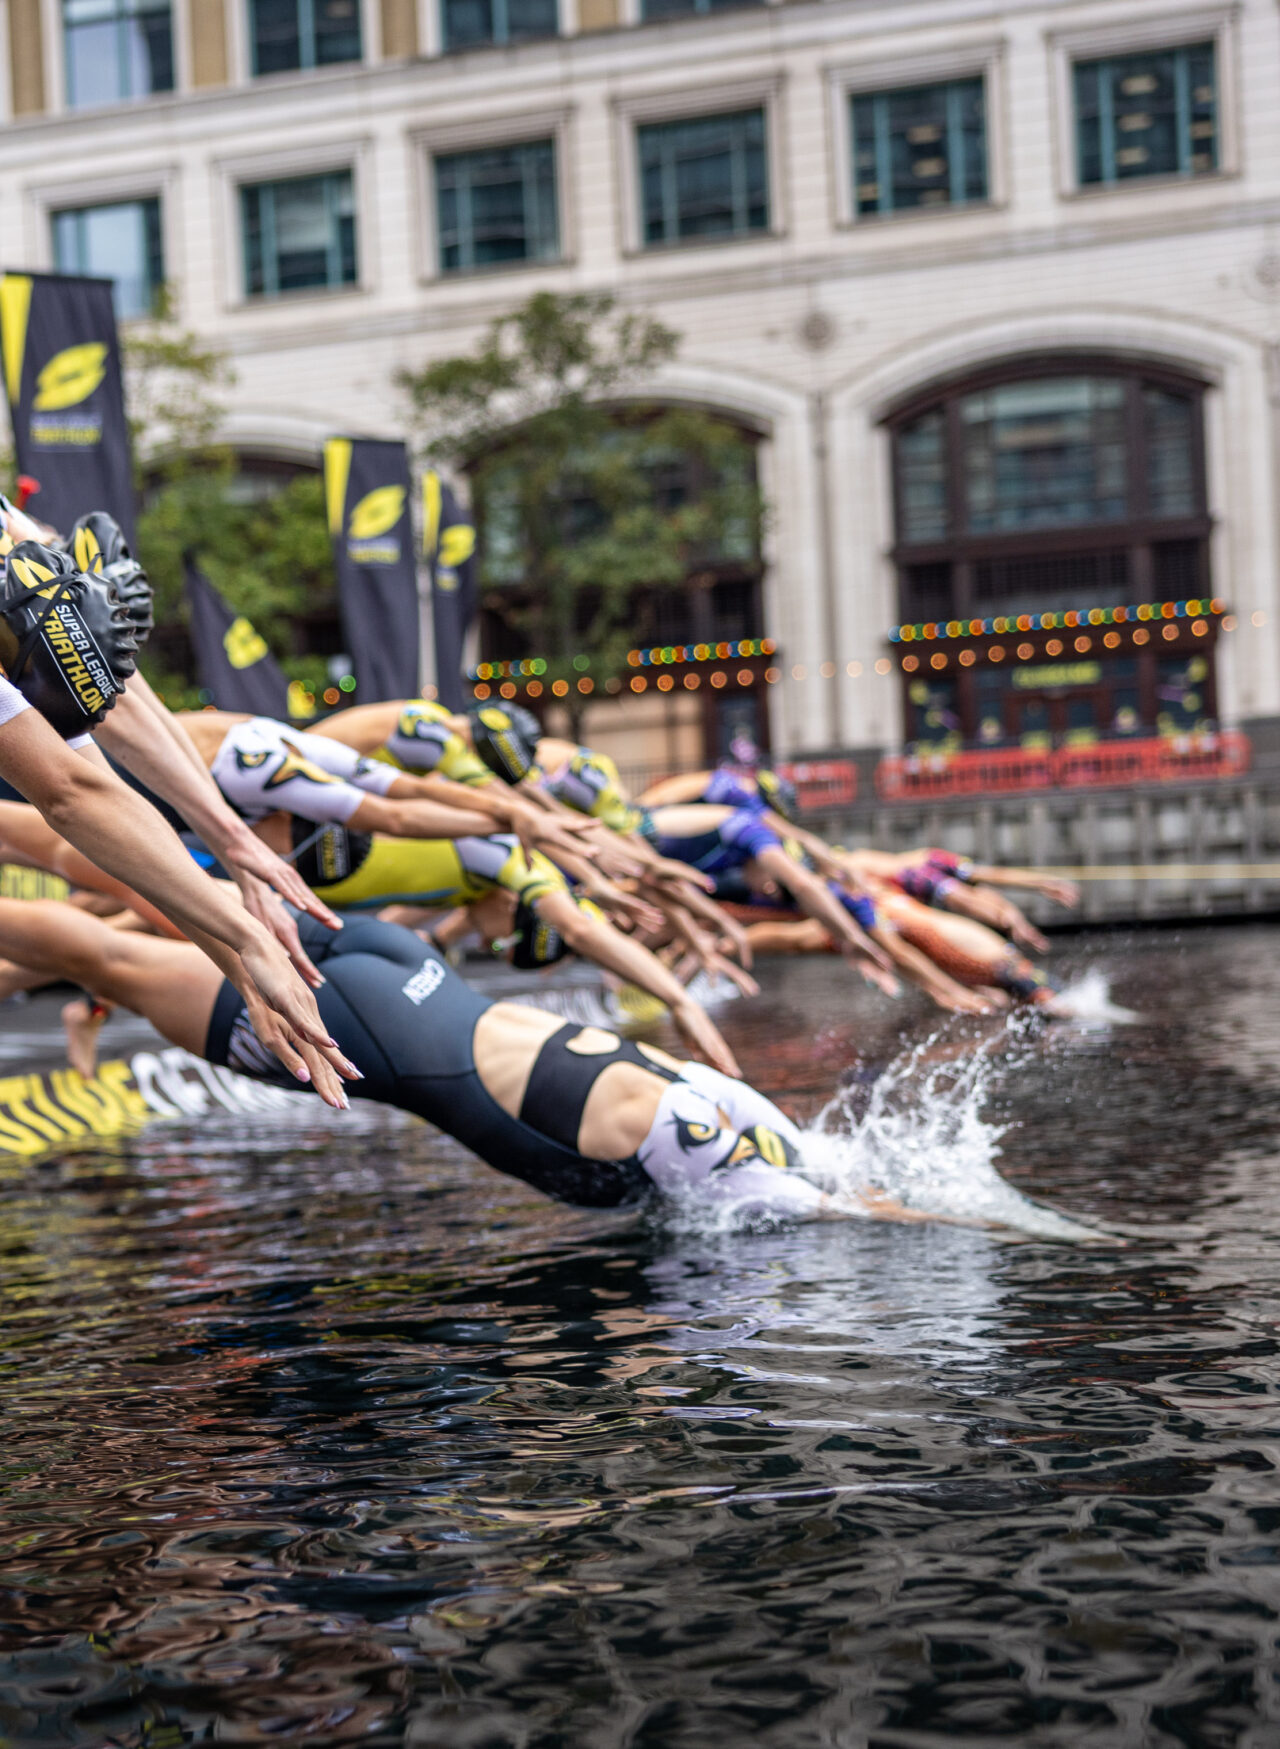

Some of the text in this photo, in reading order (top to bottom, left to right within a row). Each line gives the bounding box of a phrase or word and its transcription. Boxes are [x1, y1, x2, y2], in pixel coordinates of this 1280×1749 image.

[38, 608, 106, 714] TRIATHLON
[55, 603, 116, 699] SUPER LEAGUE
